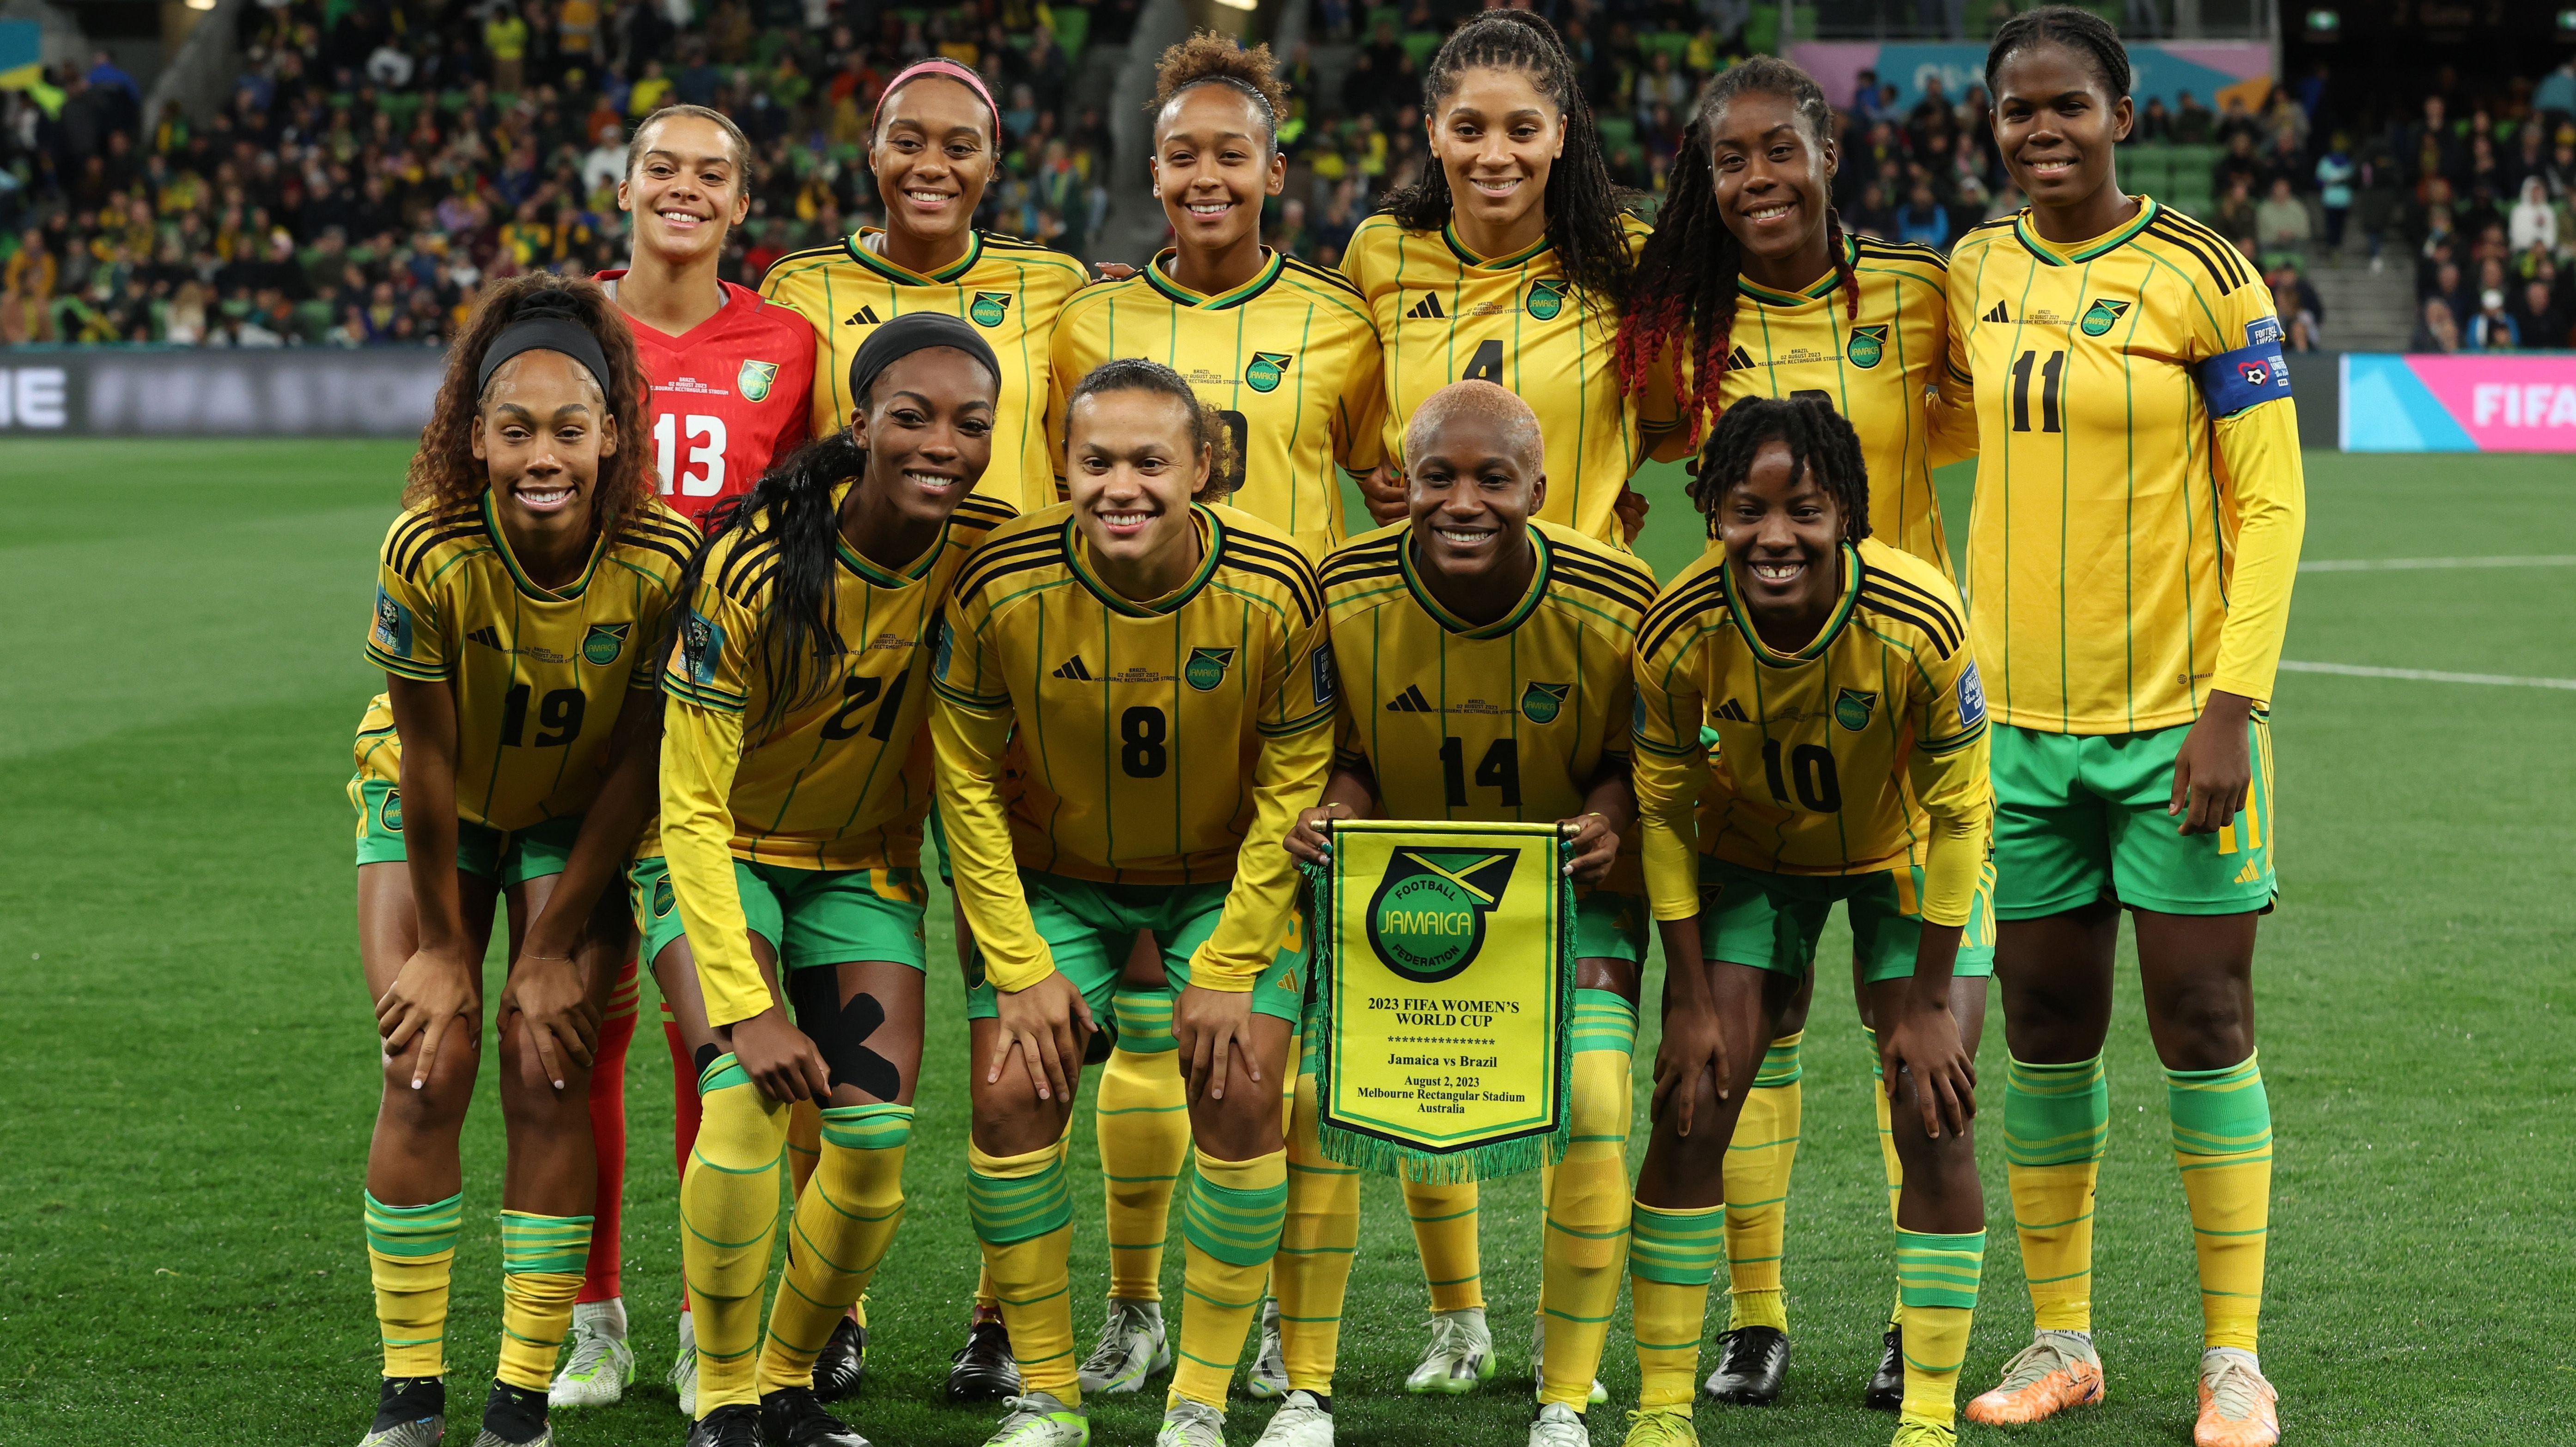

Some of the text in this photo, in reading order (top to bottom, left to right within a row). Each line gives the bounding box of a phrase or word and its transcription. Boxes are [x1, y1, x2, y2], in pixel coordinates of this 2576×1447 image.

[2083, 317, 2111, 326] JAMAICA
[1851, 346, 1879, 356] JAMAICA
[1254, 362, 1274, 370] FOOTBALL
[1462, 340, 1503, 386] 4
[1248, 372, 1277, 381] JAMAICA
[2012, 350, 2064, 433] 11
[2474, 383, 2576, 427] FIFA
[653, 413, 727, 497] 13
[586, 644, 616, 653] JAMAICA
[1188, 668, 1220, 677] JAMAICA
[820, 668, 910, 742] 21
[1525, 701, 1556, 711] JAMAICA
[1964, 693, 1976, 704] the
[500, 684, 585, 747] 19
[1121, 706, 1166, 778] 8
[1439, 737, 1523, 806] 14
[1762, 738, 1842, 813] 10
[1395, 880, 1455, 902] FOOTBALL
[1380, 910, 1471, 936] JAMAICA
[1392, 943, 1460, 967] FEDERATION
[1368, 998, 1520, 1014] 2023 FIFA WOMEN'S
[1396, 1013, 1493, 1027] WORLD CUP
[1388, 1054, 1497, 1068] Jamaica vs Brazil
[1404, 1075, 1480, 1088] August 2, 2023
[1358, 1087, 1525, 1102] Melbourne Rectangular Stadium
[1417, 1103, 1465, 1114] Australia
